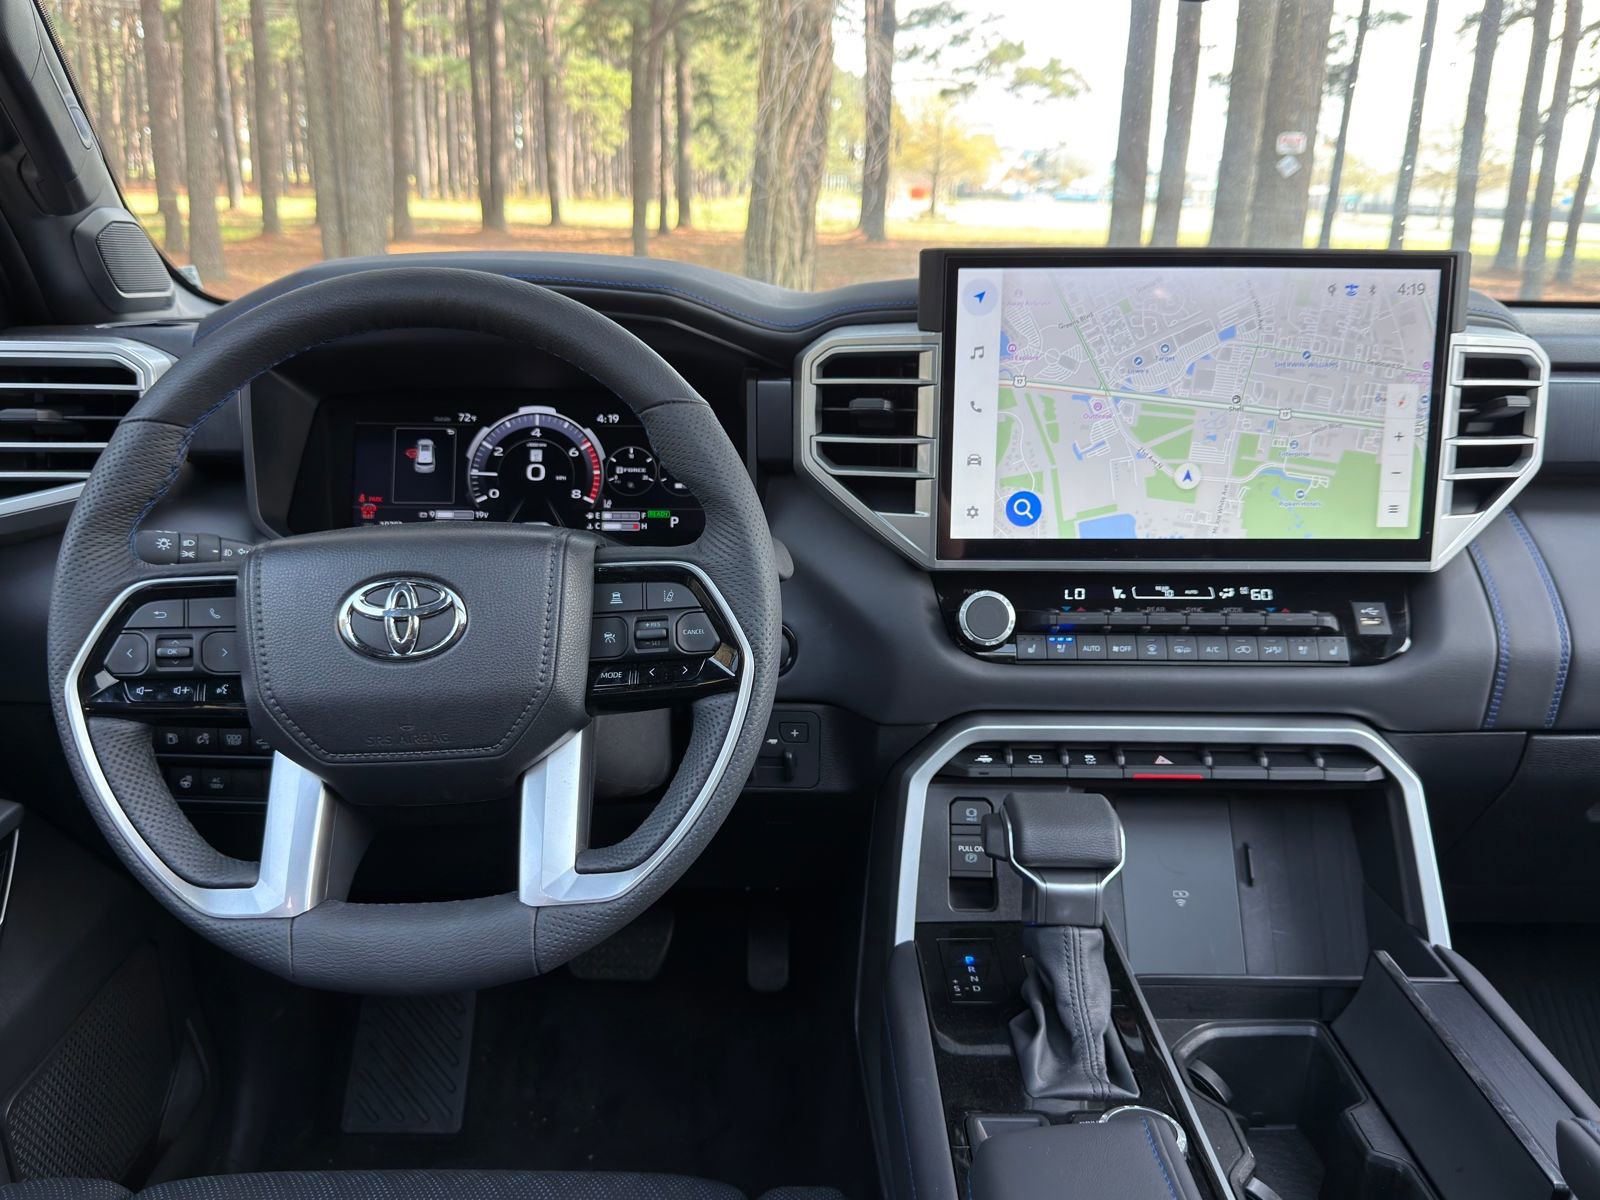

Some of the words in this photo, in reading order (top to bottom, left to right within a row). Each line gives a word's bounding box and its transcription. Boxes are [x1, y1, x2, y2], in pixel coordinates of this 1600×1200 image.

[1397, 282, 1426, 296] 4:19
[1154, 355, 1176, 363] Target
[596, 413, 620, 424] 4:19
[530, 428, 542, 438] 4
[493, 446, 504, 457] 2
[568, 446, 579, 457] 6
[525, 463, 546, 481] 0
[487, 488, 500, 499] 0
[570, 488, 582, 499] 8
[428, 510, 435, 518] 9
[594, 511, 601, 520] E
[640, 511, 647, 520] F
[594, 522, 601, 530] C
[669, 516, 680, 529] P
[1064, 587, 1086, 600] LO
[1250, 588, 1274, 601] 60
[682, 628, 705, 636] CANCEL
[1082, 644, 1101, 653] AUTO
[1205, 645, 1220, 653] A/C
[600, 671, 623, 679] MODE
[967, 965, 977, 973] R
[969, 975, 980, 983] N
[972, 984, 982, 992] D
